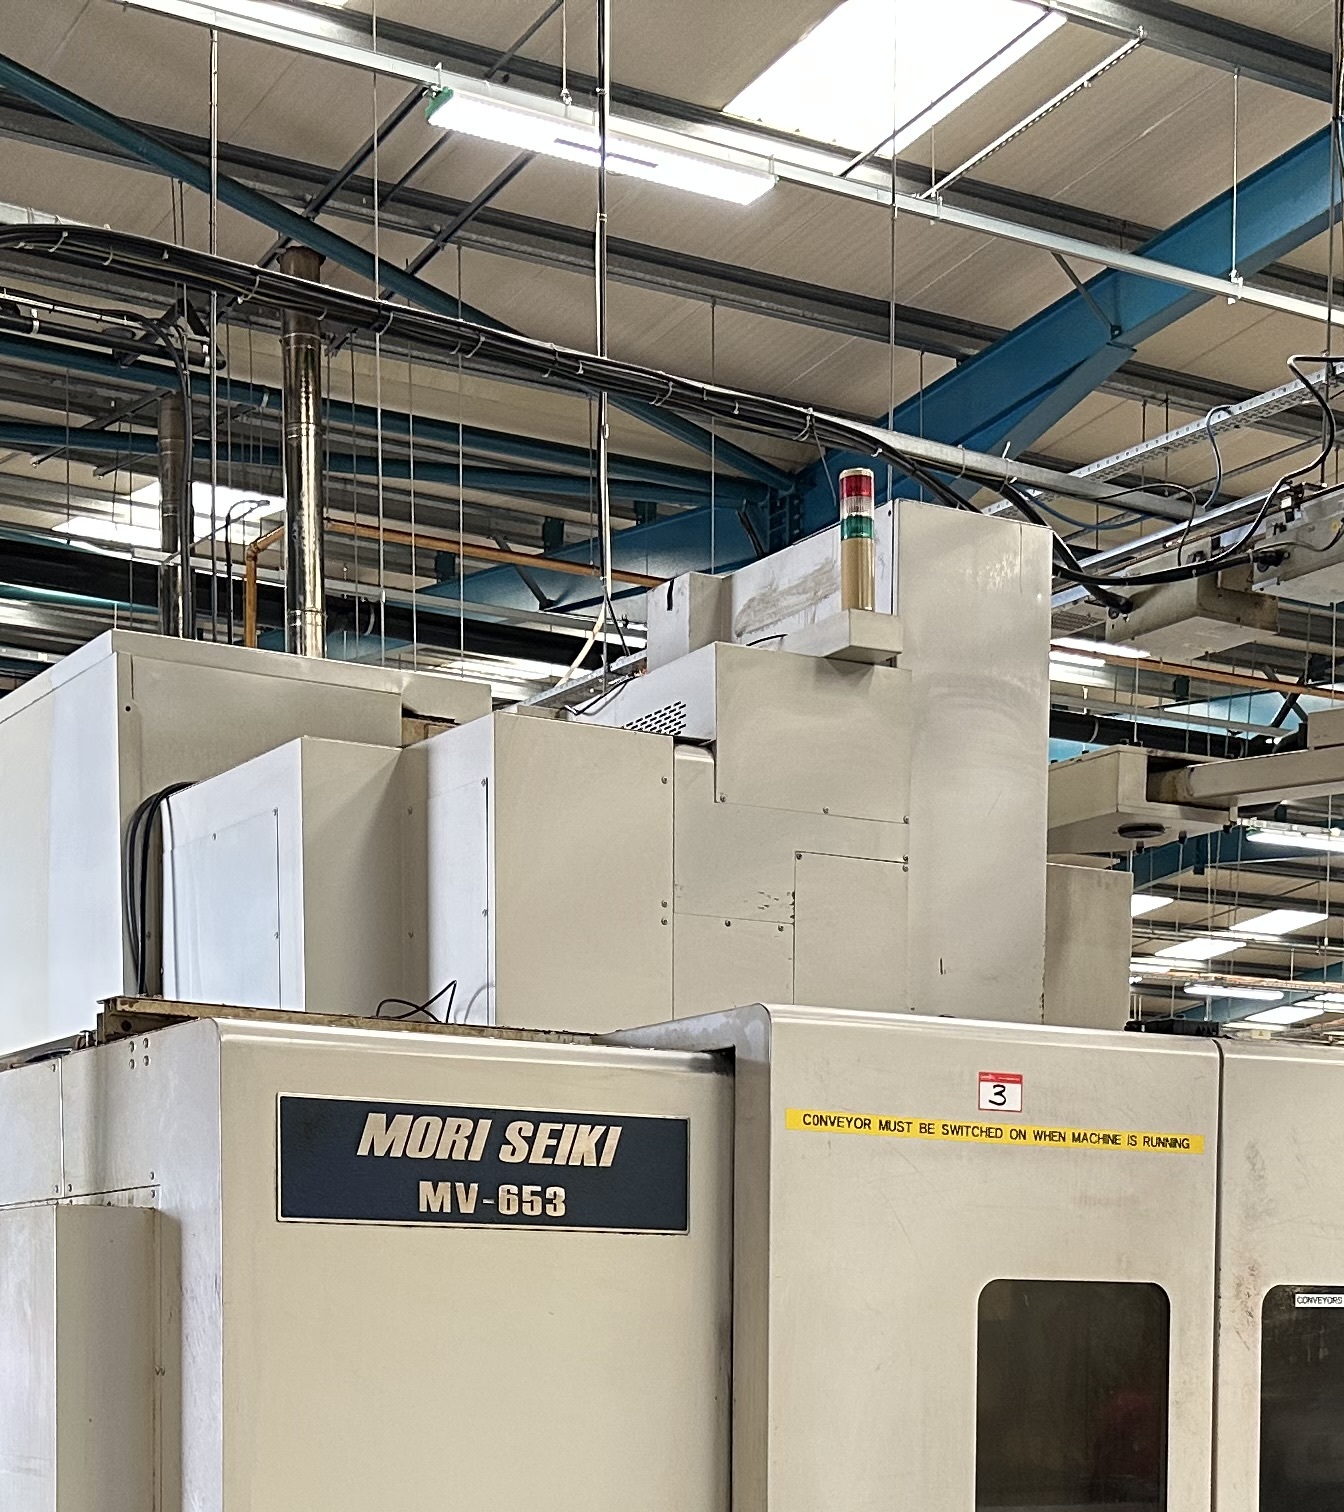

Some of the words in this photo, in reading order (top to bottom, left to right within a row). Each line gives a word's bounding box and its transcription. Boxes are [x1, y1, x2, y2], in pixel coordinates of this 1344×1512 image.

[988, 1084, 1006, 1106] 3
[356, 1112, 493, 1161] MORI
[498, 1120, 623, 1168] SEIKI
[802, 1113, 871, 1130] CONVEYOR
[879, 1119, 913, 1133] MUST
[919, 1122, 935, 1135] BE
[942, 1124, 1003, 1139] SWITCHED
[1009, 1128, 1027, 1141] ON
[1033, 1129, 1066, 1143] WHEN
[1072, 1132, 1121, 1146] MACHINE
[1127, 1134, 1138, 1147] IS
[1143, 1135, 1190, 1149] RUNNING
[419, 1180, 566, 1217] MV-653
[1296, 1296, 1342, 1305] CONVEYORS
